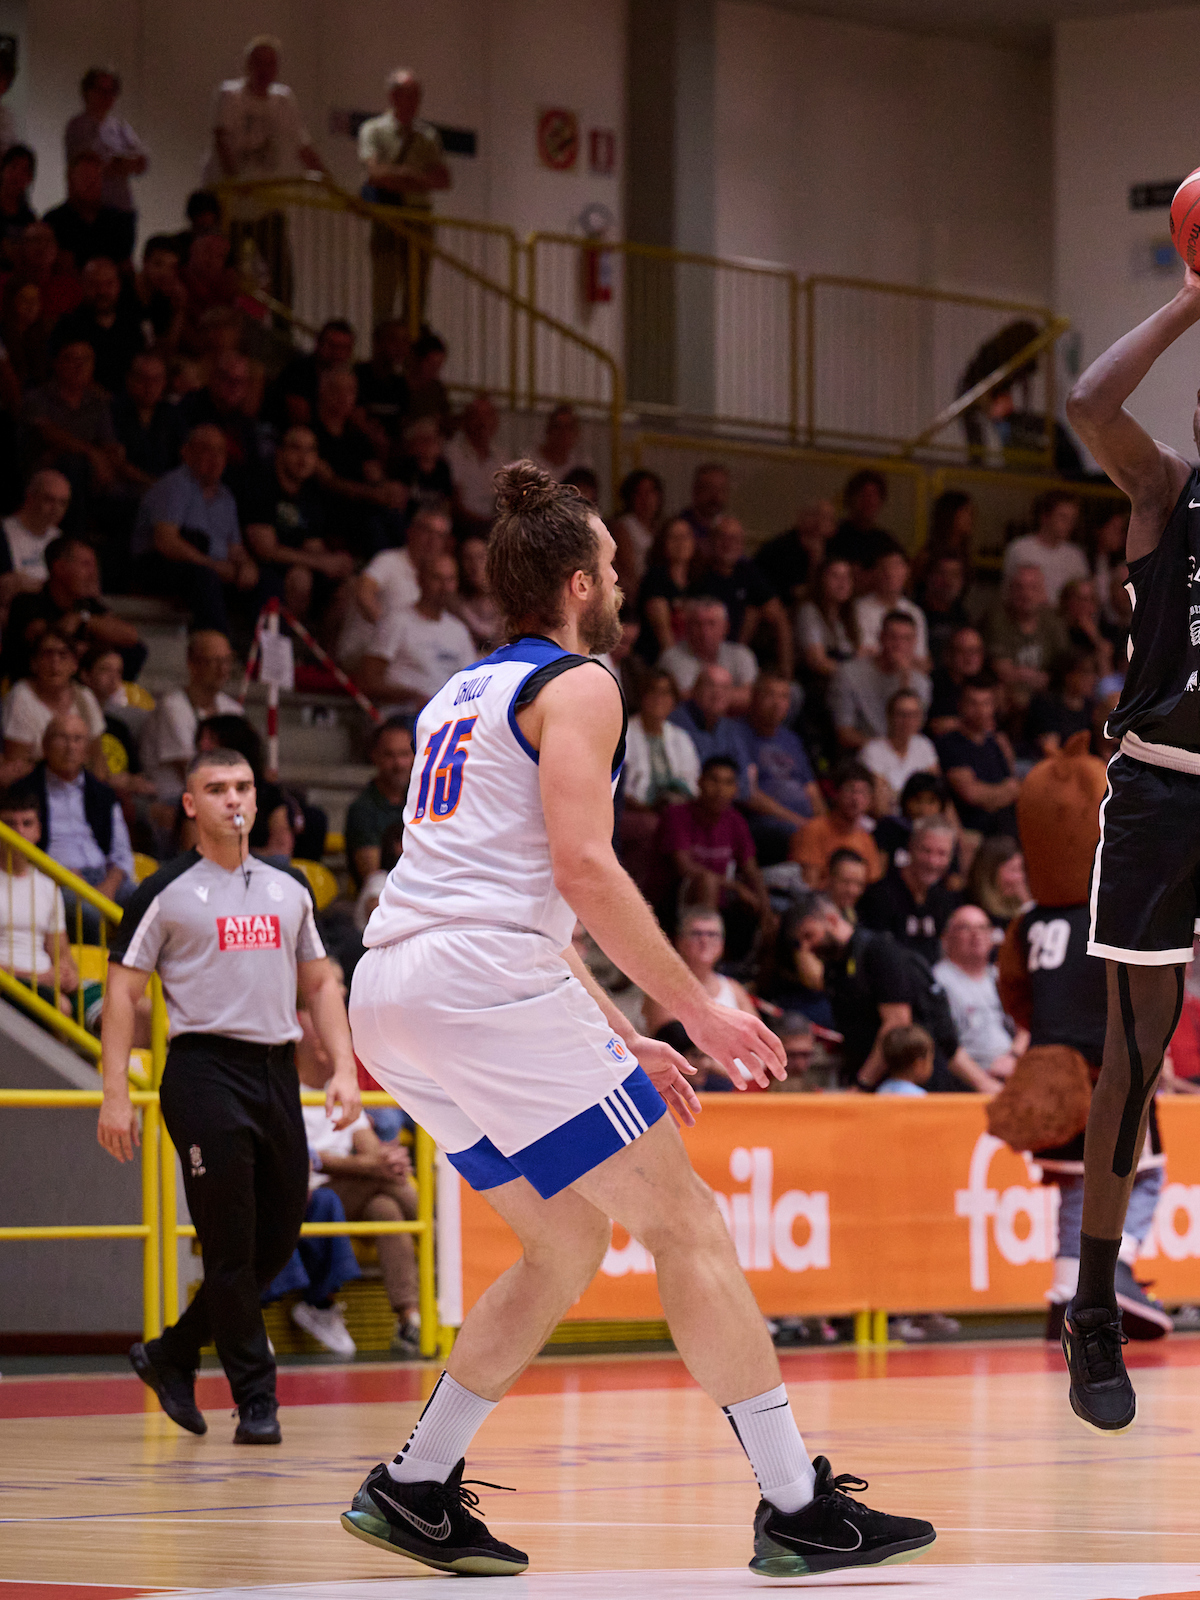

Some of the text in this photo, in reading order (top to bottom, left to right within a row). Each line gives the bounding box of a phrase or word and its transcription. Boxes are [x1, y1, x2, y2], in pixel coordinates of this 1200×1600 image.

[408, 714, 479, 824] 15
[224, 915, 275, 933] ATTAL
[224, 931, 276, 943] GROUP
[602, 1148, 830, 1277] aila
